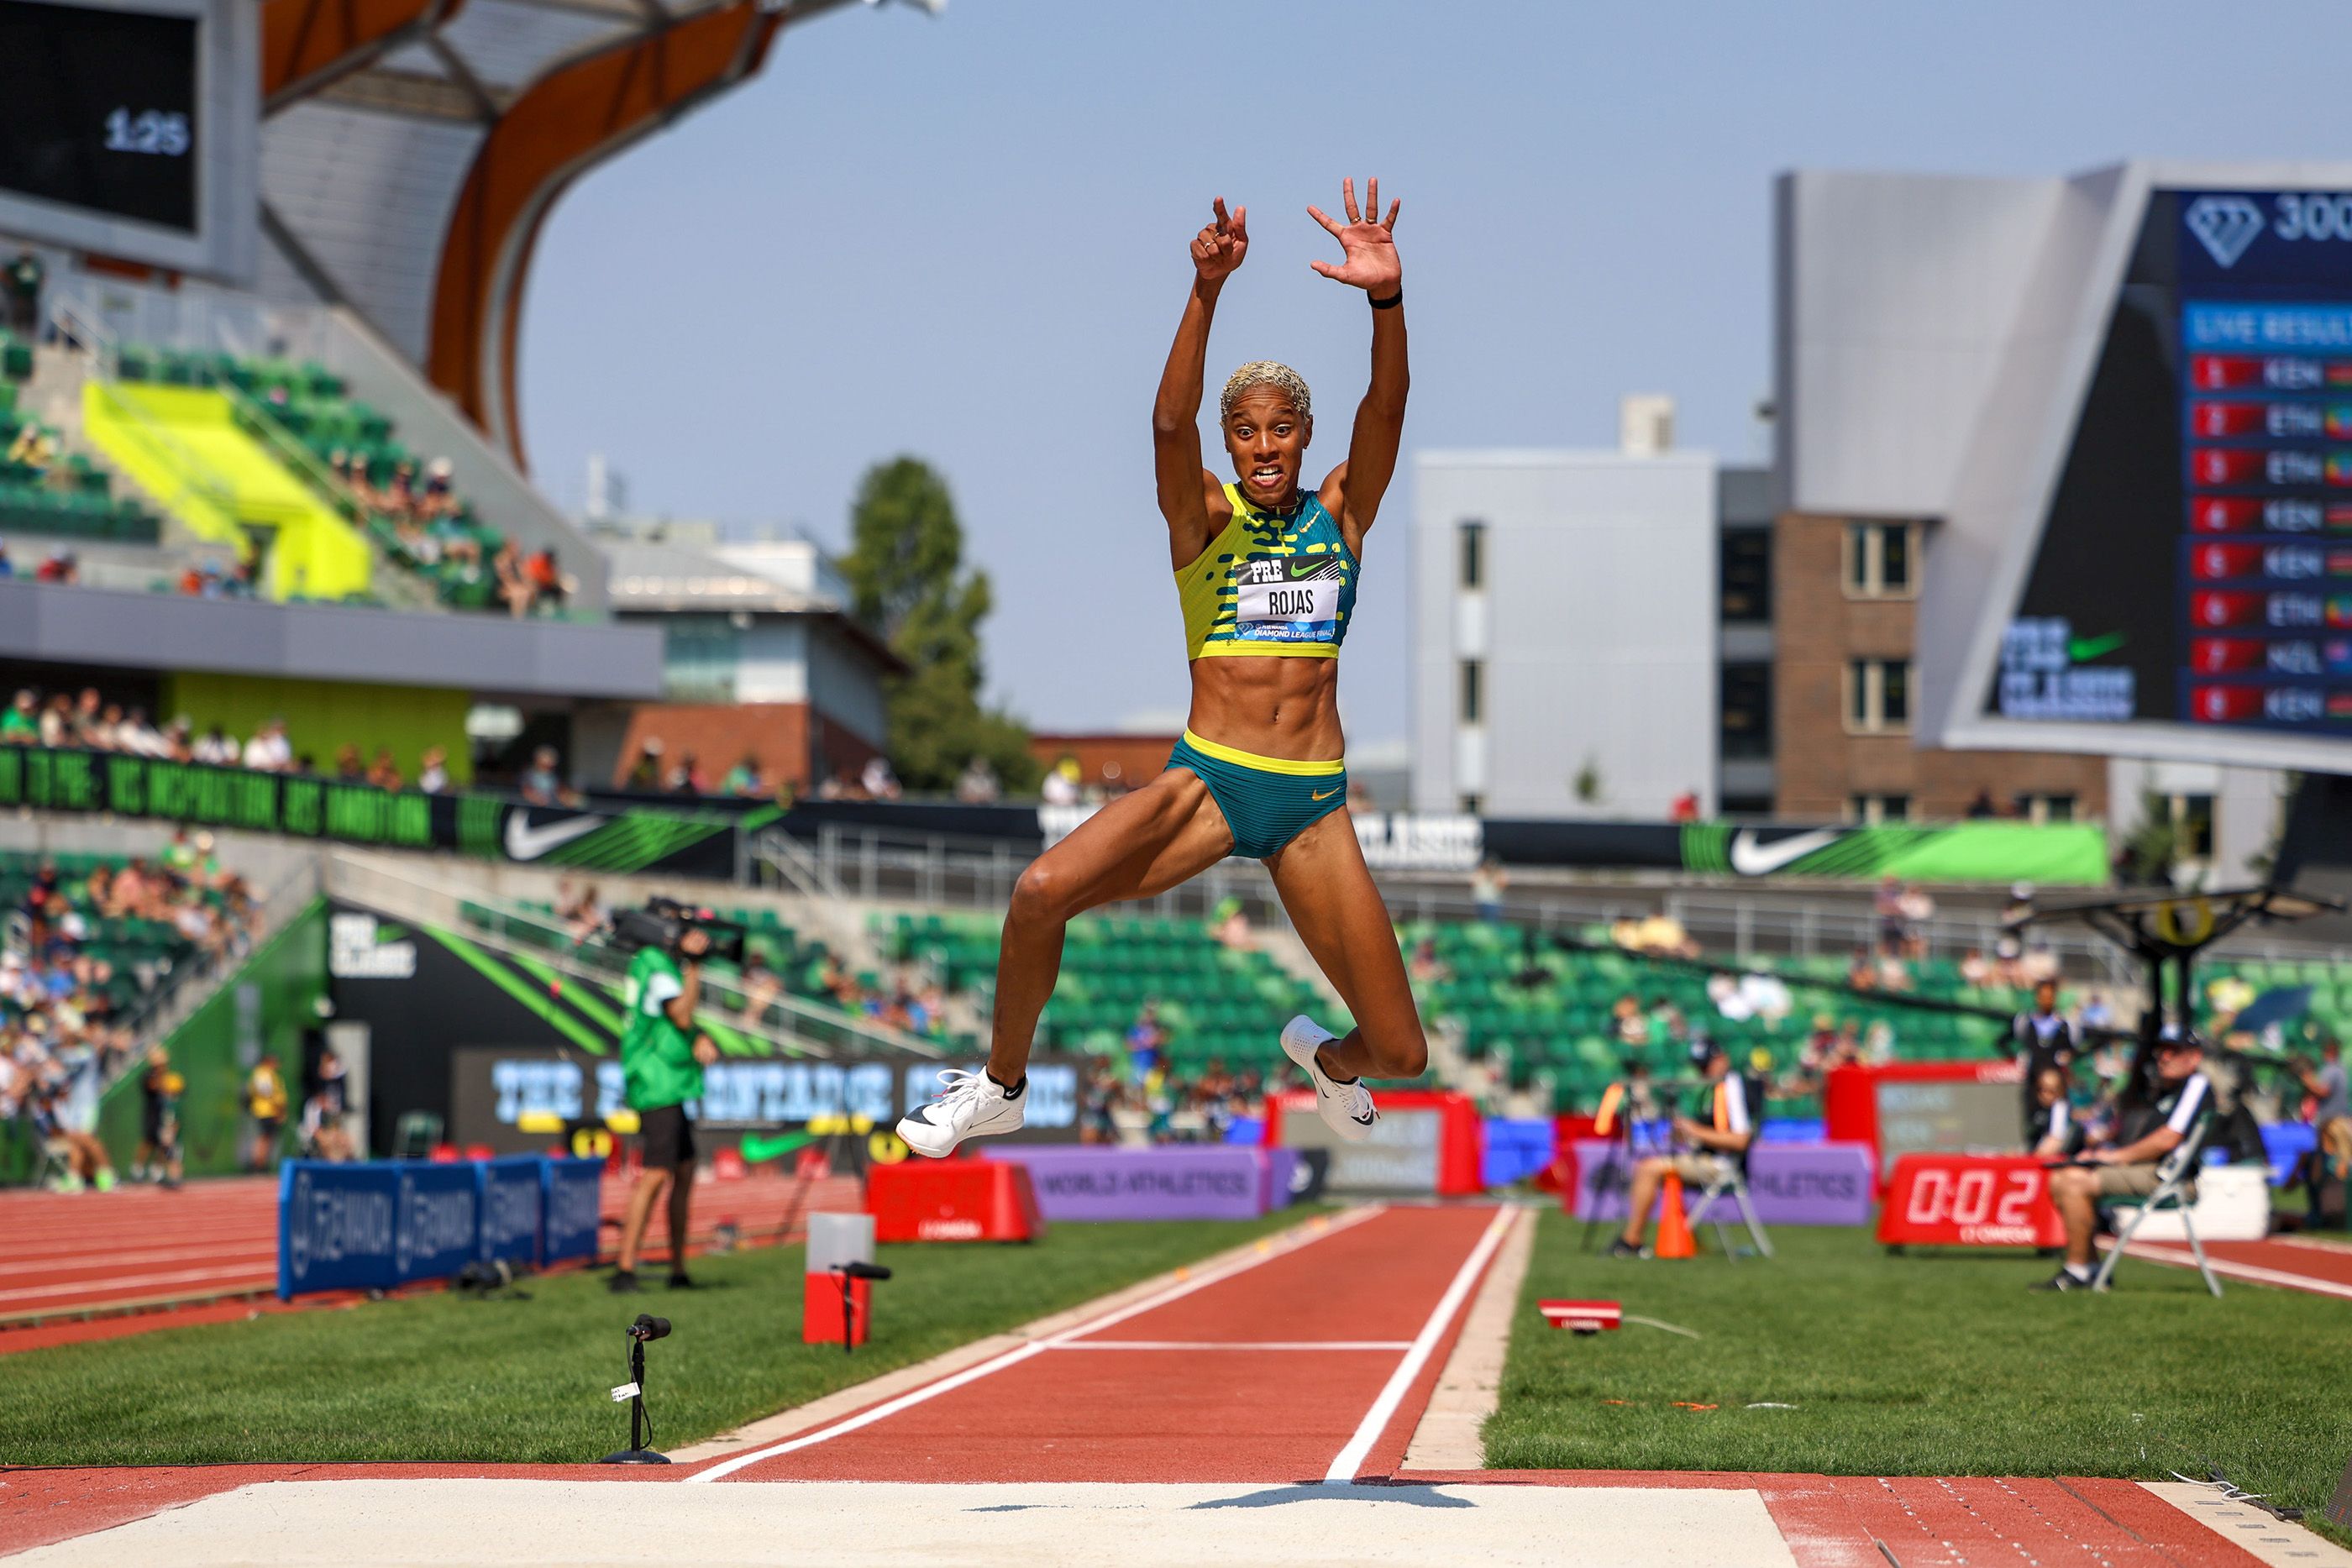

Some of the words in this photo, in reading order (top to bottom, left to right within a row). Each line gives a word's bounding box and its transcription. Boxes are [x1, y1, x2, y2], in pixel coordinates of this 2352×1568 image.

[2265, 357, 2323, 391] KEN
[2265, 403, 2323, 437] ETH
[2265, 449, 2323, 484] ETH
[2265, 499, 2323, 532] KEN
[1251, 559, 1284, 583] PRE
[2265, 545, 2325, 579] KEN
[1269, 590, 1314, 616] ROJAS
[2267, 592, 2323, 627] ETH
[1254, 629, 1290, 638] DIAMOND
[2265, 687, 2325, 721] KEN
